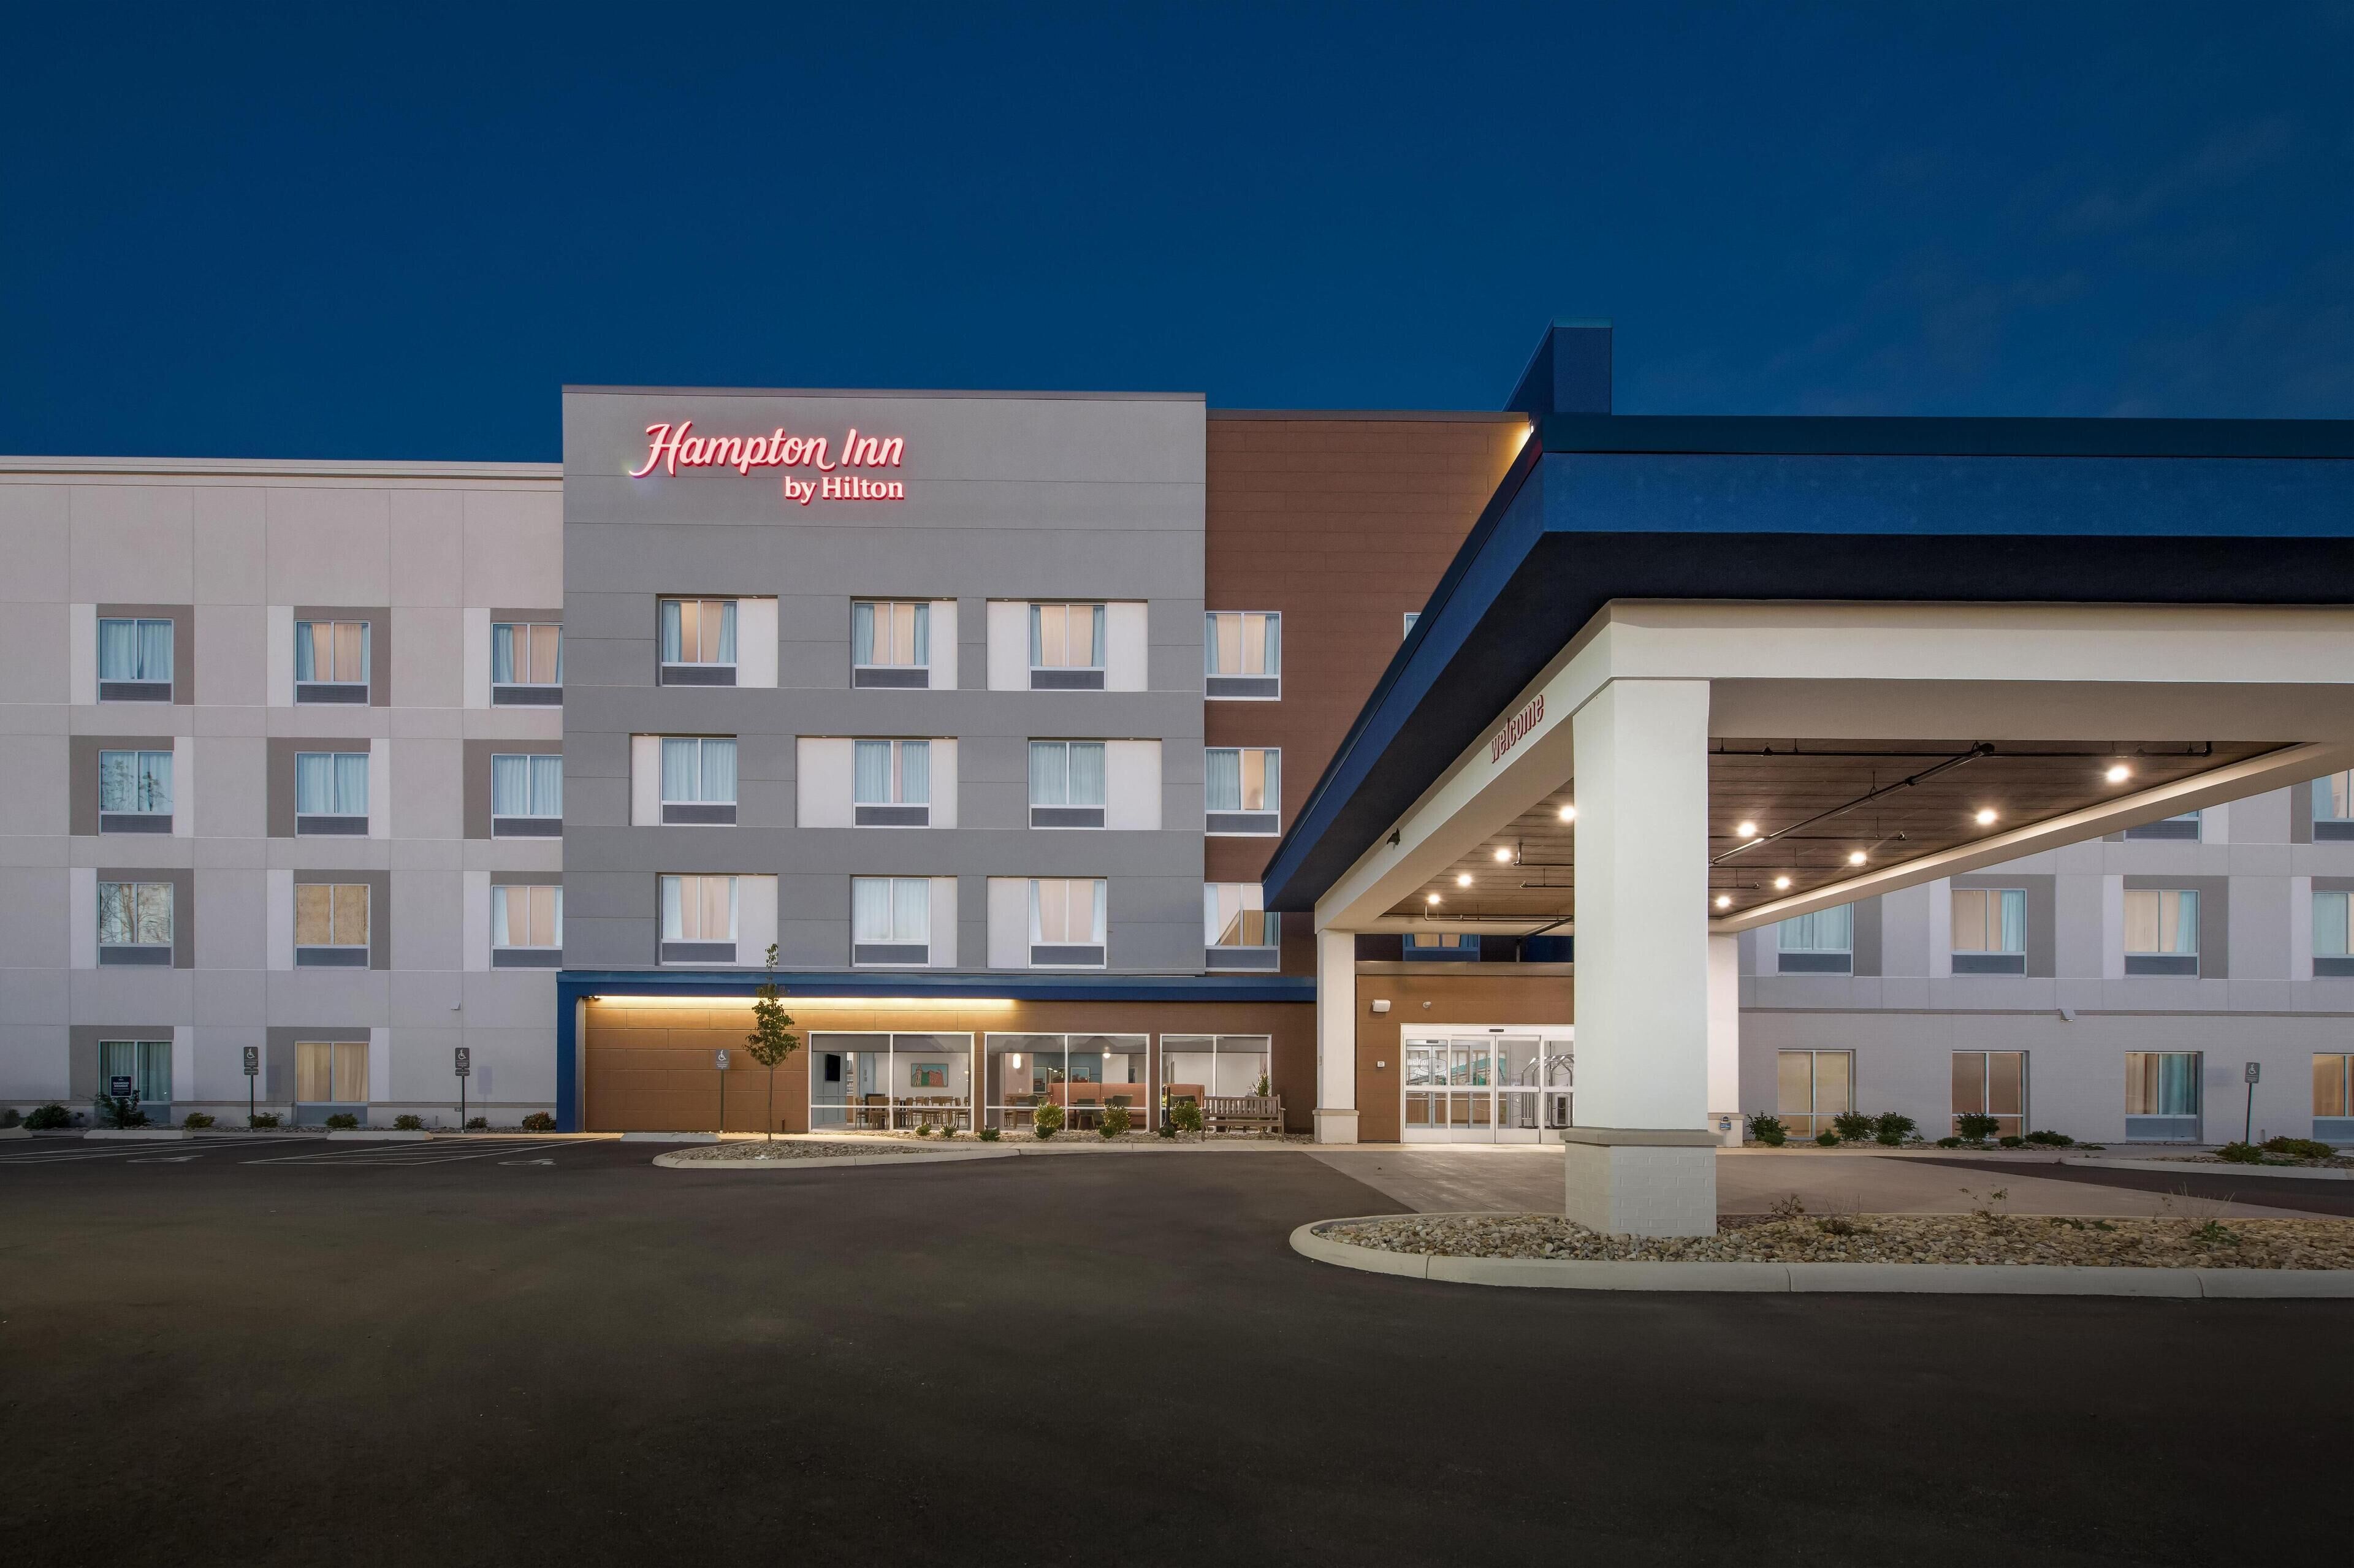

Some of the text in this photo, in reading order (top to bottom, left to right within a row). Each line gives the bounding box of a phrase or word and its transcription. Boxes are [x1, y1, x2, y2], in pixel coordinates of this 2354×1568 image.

[628, 421, 904, 477] Hampton Inn
[785, 476, 905, 506] by Hilton
[1491, 694, 1544, 764] welcome
